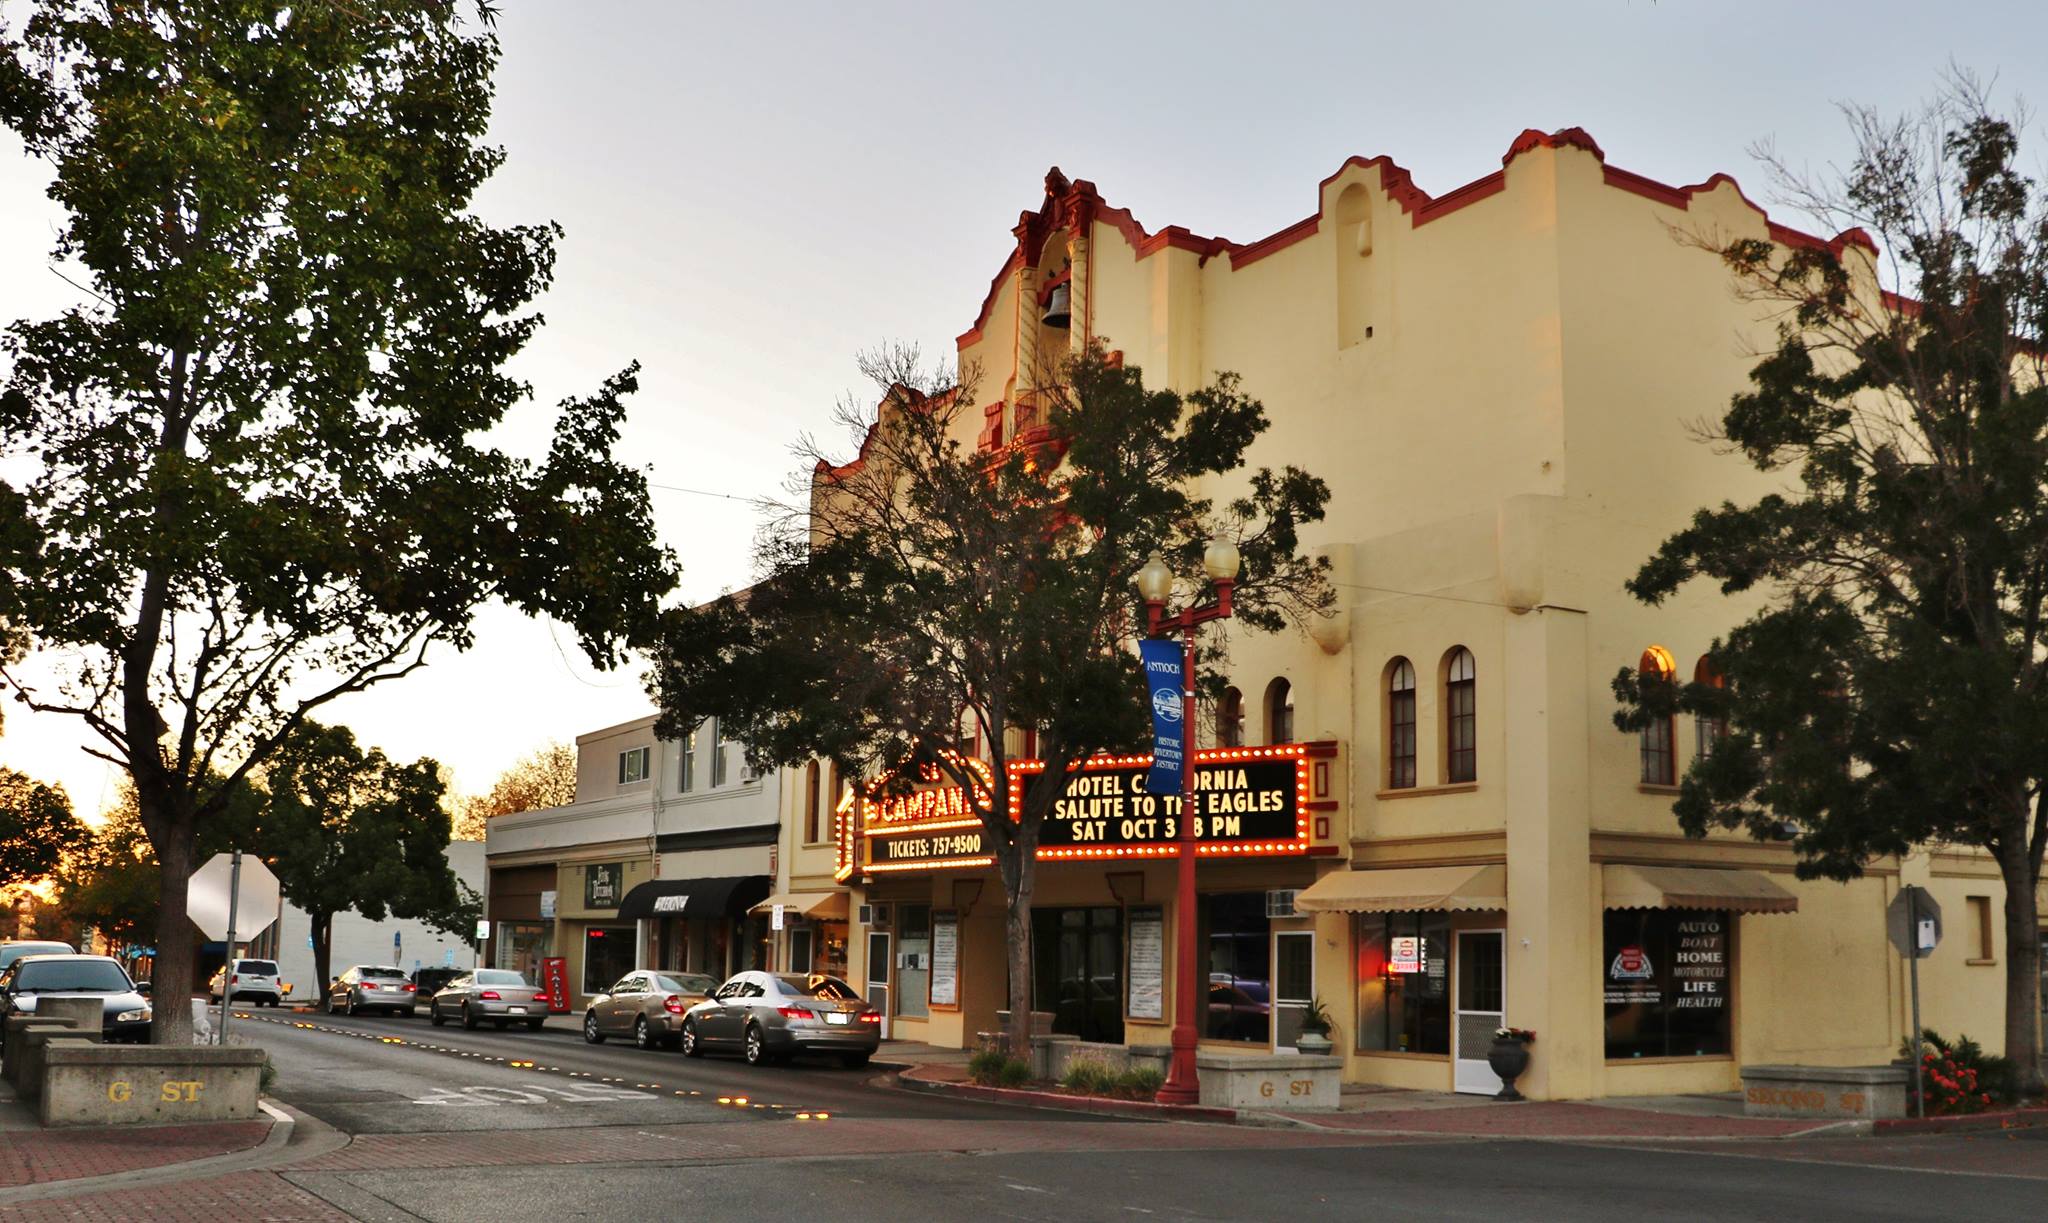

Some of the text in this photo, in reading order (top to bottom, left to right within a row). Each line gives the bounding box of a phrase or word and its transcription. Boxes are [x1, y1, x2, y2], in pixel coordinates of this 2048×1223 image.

[1147, 661, 1181, 674] ANTIOCH
[1158, 737, 1180, 749] HISTORIC
[1156, 759, 1179, 770] DISTRICT
[1066, 775, 1124, 797] HOTEL
[1055, 797, 1124, 820] SALUTE
[1131, 796, 1156, 817] TO
[1208, 790, 1284, 814] EAGLES
[1072, 821, 1107, 841] SAT
[1121, 818, 1157, 840] OCT
[1212, 815, 1240, 837] PM
[888, 834, 981, 859] TICKETS: 757-9500
[1678, 922, 1720, 933] AUTO
[1681, 938, 1718, 948] BOAT
[1676, 952, 1723, 963] HOME
[1673, 967, 1725, 978] MOTORCYCLE
[1683, 982, 1717, 992] LIFE
[1676, 997, 1723, 1008] HEALTH
[108, 1081, 205, 1103] G ST
[1260, 1080, 1314, 1097] G ST
[1747, 1087, 1866, 1113] SECOND ST
